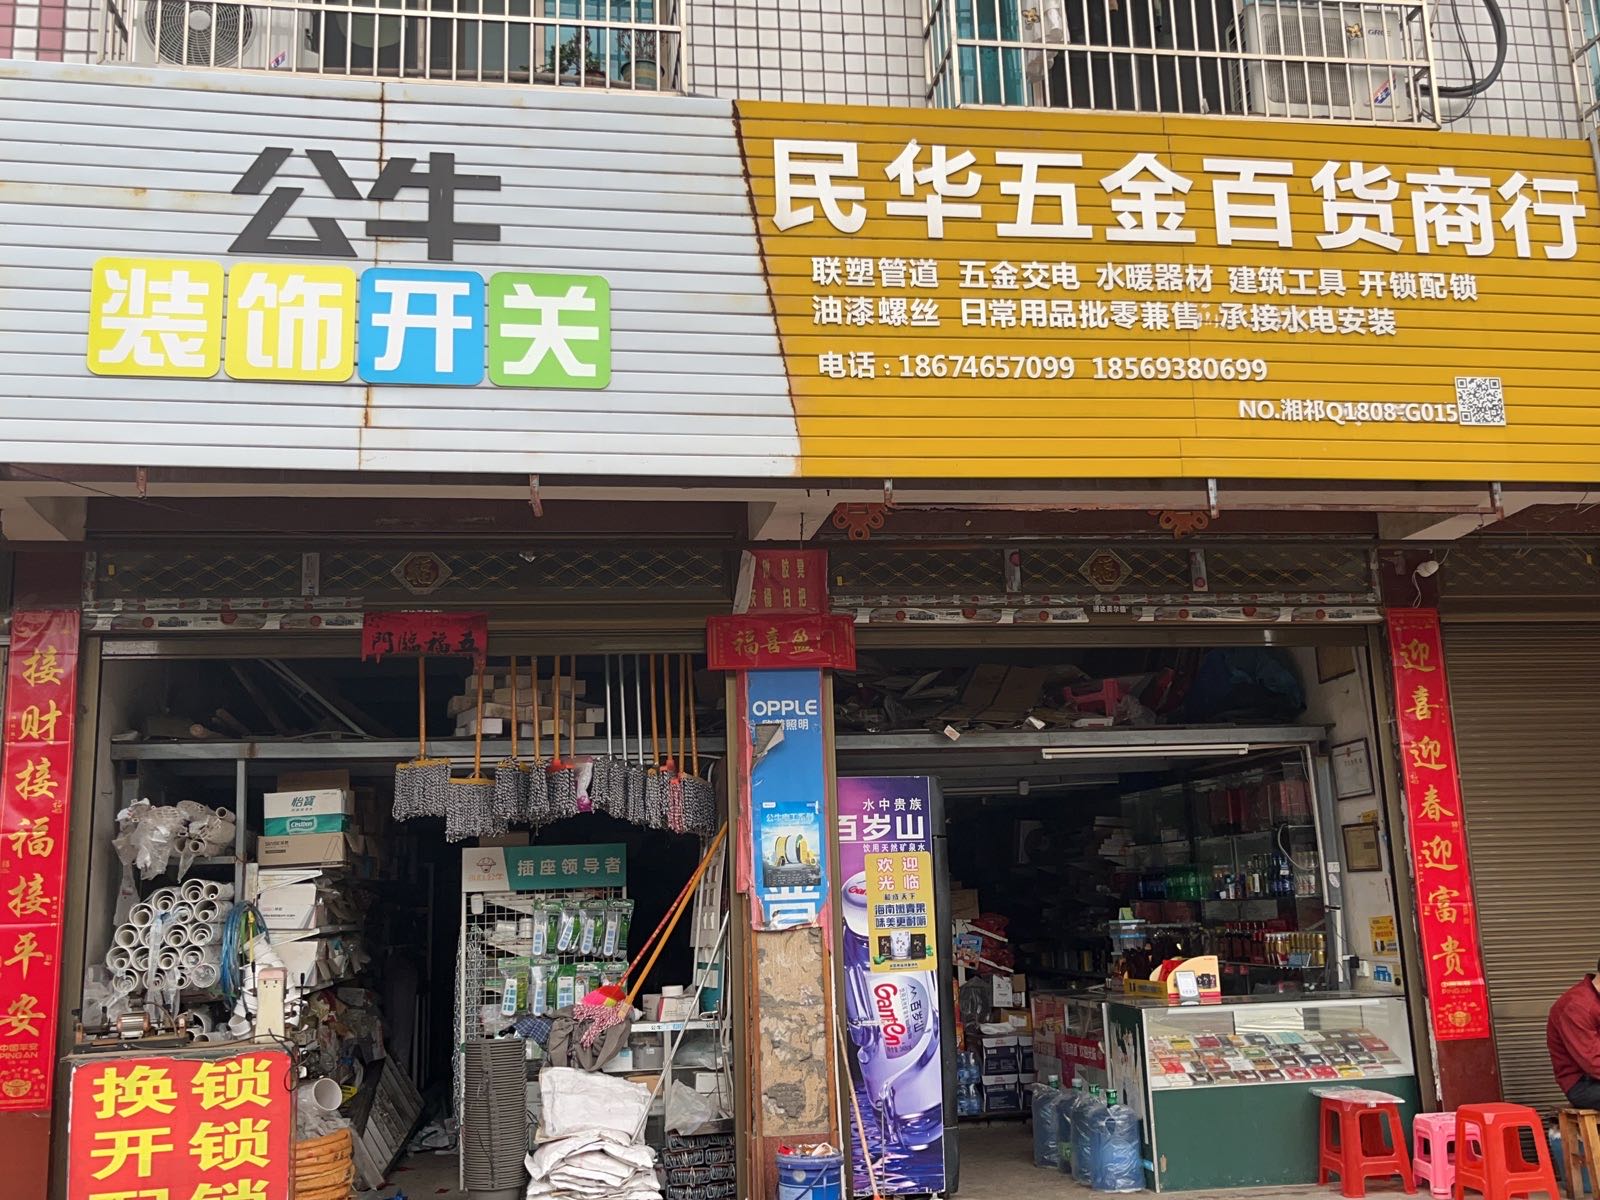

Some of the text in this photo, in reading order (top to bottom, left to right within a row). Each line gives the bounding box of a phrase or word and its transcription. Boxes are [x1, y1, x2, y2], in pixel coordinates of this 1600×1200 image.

[228, 146, 501, 260] 公牛
[772, 138, 1586, 260] 民华五金百货商行
[811, 257, 1479, 301] 联塑管道 五金交电 水暖器材 建筑工具 开锁配锁
[99, 267, 600, 377] 装饰开关
[812, 296, 1397, 336] 油漆螺丝 日常用品批零兼售 承接水电安装
[1092, 356, 1268, 382] 18569380699
[752, 700, 817, 716] OPPLE
[862, 797, 922, 812] 水中贵族
[1400, 638, 1466, 976] 迎喜迎春迎富贵
[838, 813, 925, 841] 百岁山
[517, 856, 621, 877] 插座领导者
[877, 856, 918, 873] 欢迎
[878, 874, 920, 891] 光临
[92, 1057, 273, 1119] 换锁
[90, 1117, 272, 1181] 开锁
